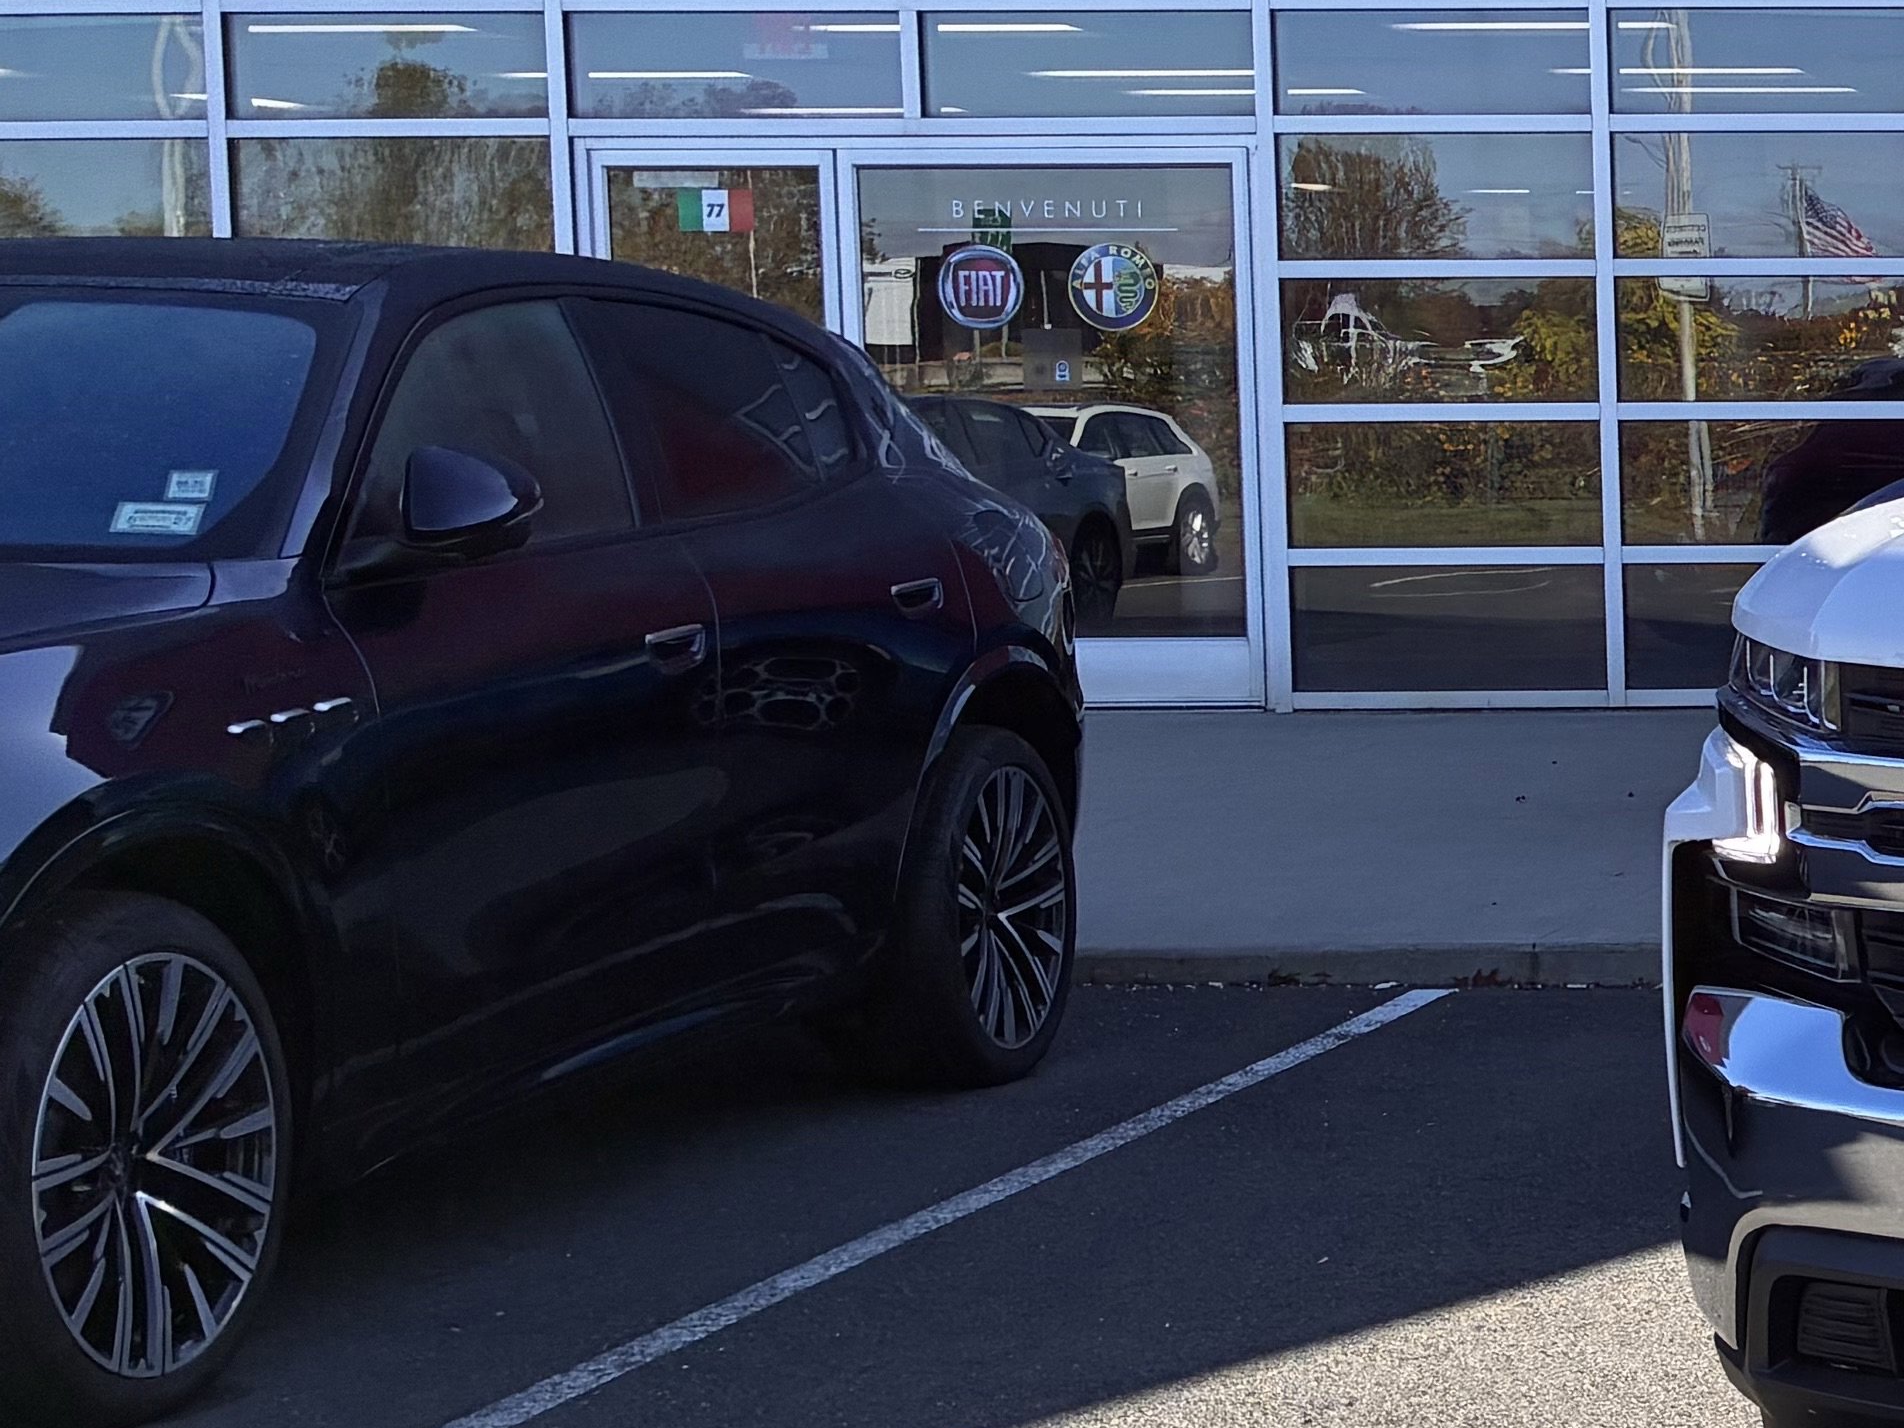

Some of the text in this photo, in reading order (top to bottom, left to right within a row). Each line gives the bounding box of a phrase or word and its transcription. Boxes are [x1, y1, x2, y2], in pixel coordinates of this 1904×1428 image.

[706, 203, 725, 218] 77
[951, 199, 1143, 219] BENVENUTI
[957, 270, 1005, 308] FIAT
